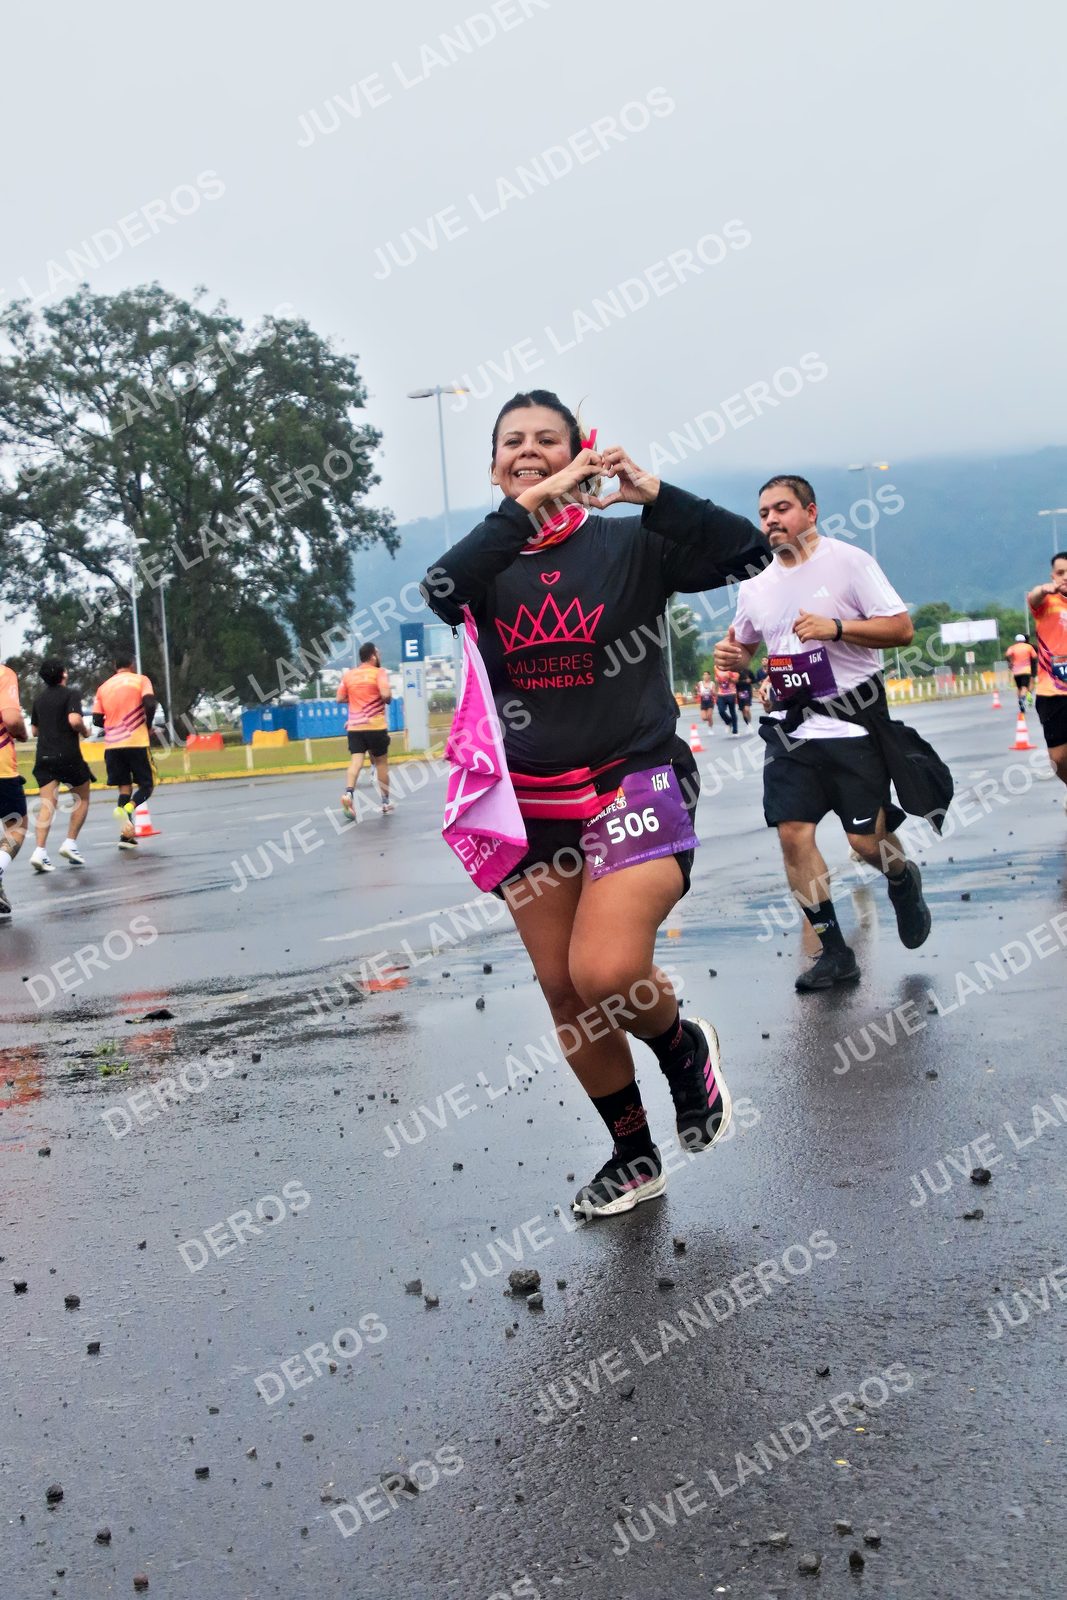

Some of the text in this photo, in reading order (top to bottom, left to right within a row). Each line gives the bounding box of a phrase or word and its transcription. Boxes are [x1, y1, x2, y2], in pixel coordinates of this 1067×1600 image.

[405, 639, 419, 657] E
[506, 653, 593, 676] MUJERES
[782, 671, 811, 688] 301
[651, 772, 670, 792] 15K
[606, 807, 660, 845] 506
